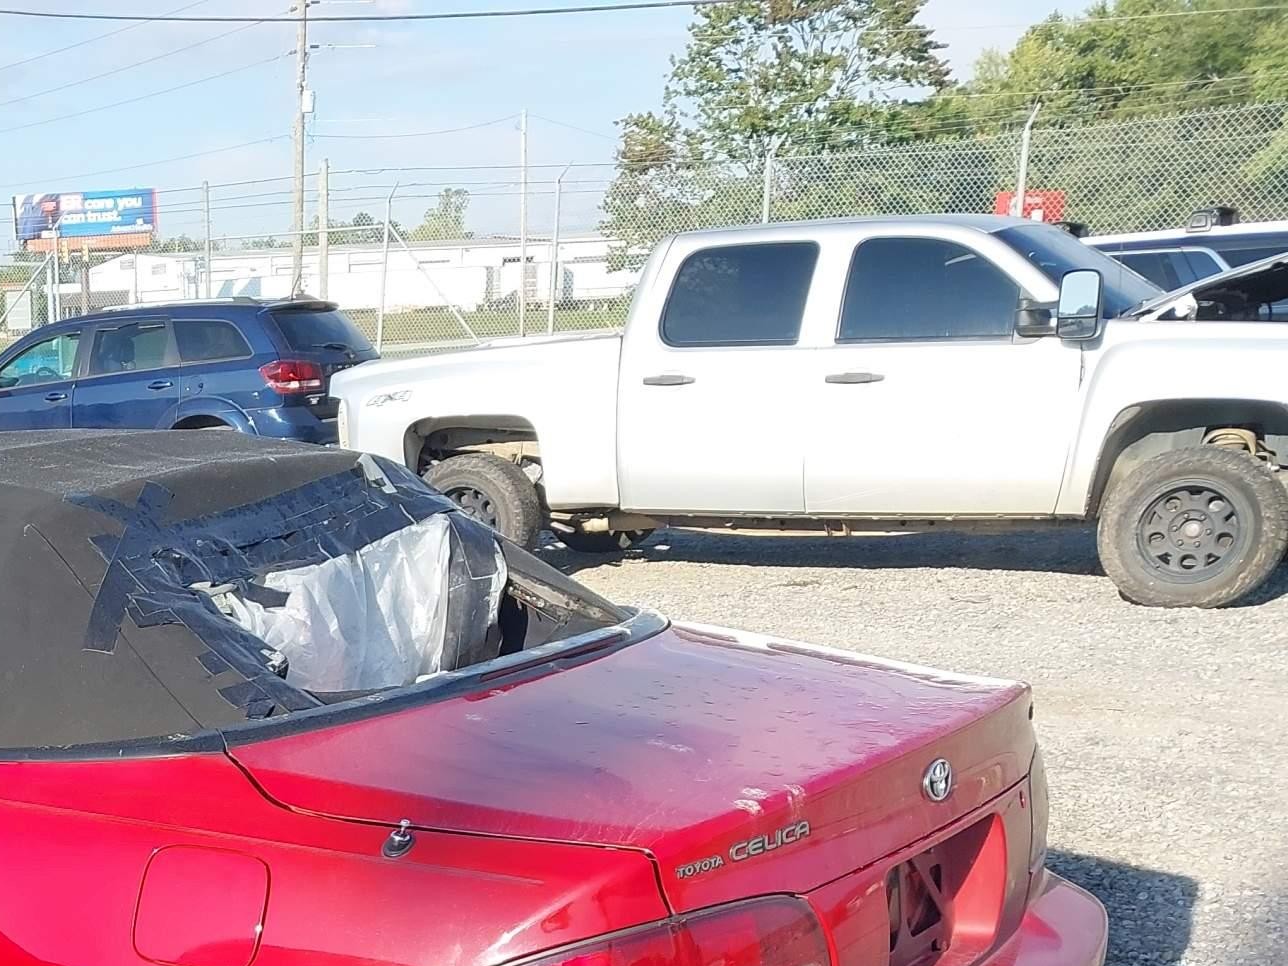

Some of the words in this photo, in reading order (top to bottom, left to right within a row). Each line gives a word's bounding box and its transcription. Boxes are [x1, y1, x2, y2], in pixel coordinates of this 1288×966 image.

[84, 199, 114, 209] care
[117, 197, 142, 211] you
[62, 213, 85, 224] can
[676, 855, 724, 879] TOYOTA
[728, 820, 811, 861] CELICA
